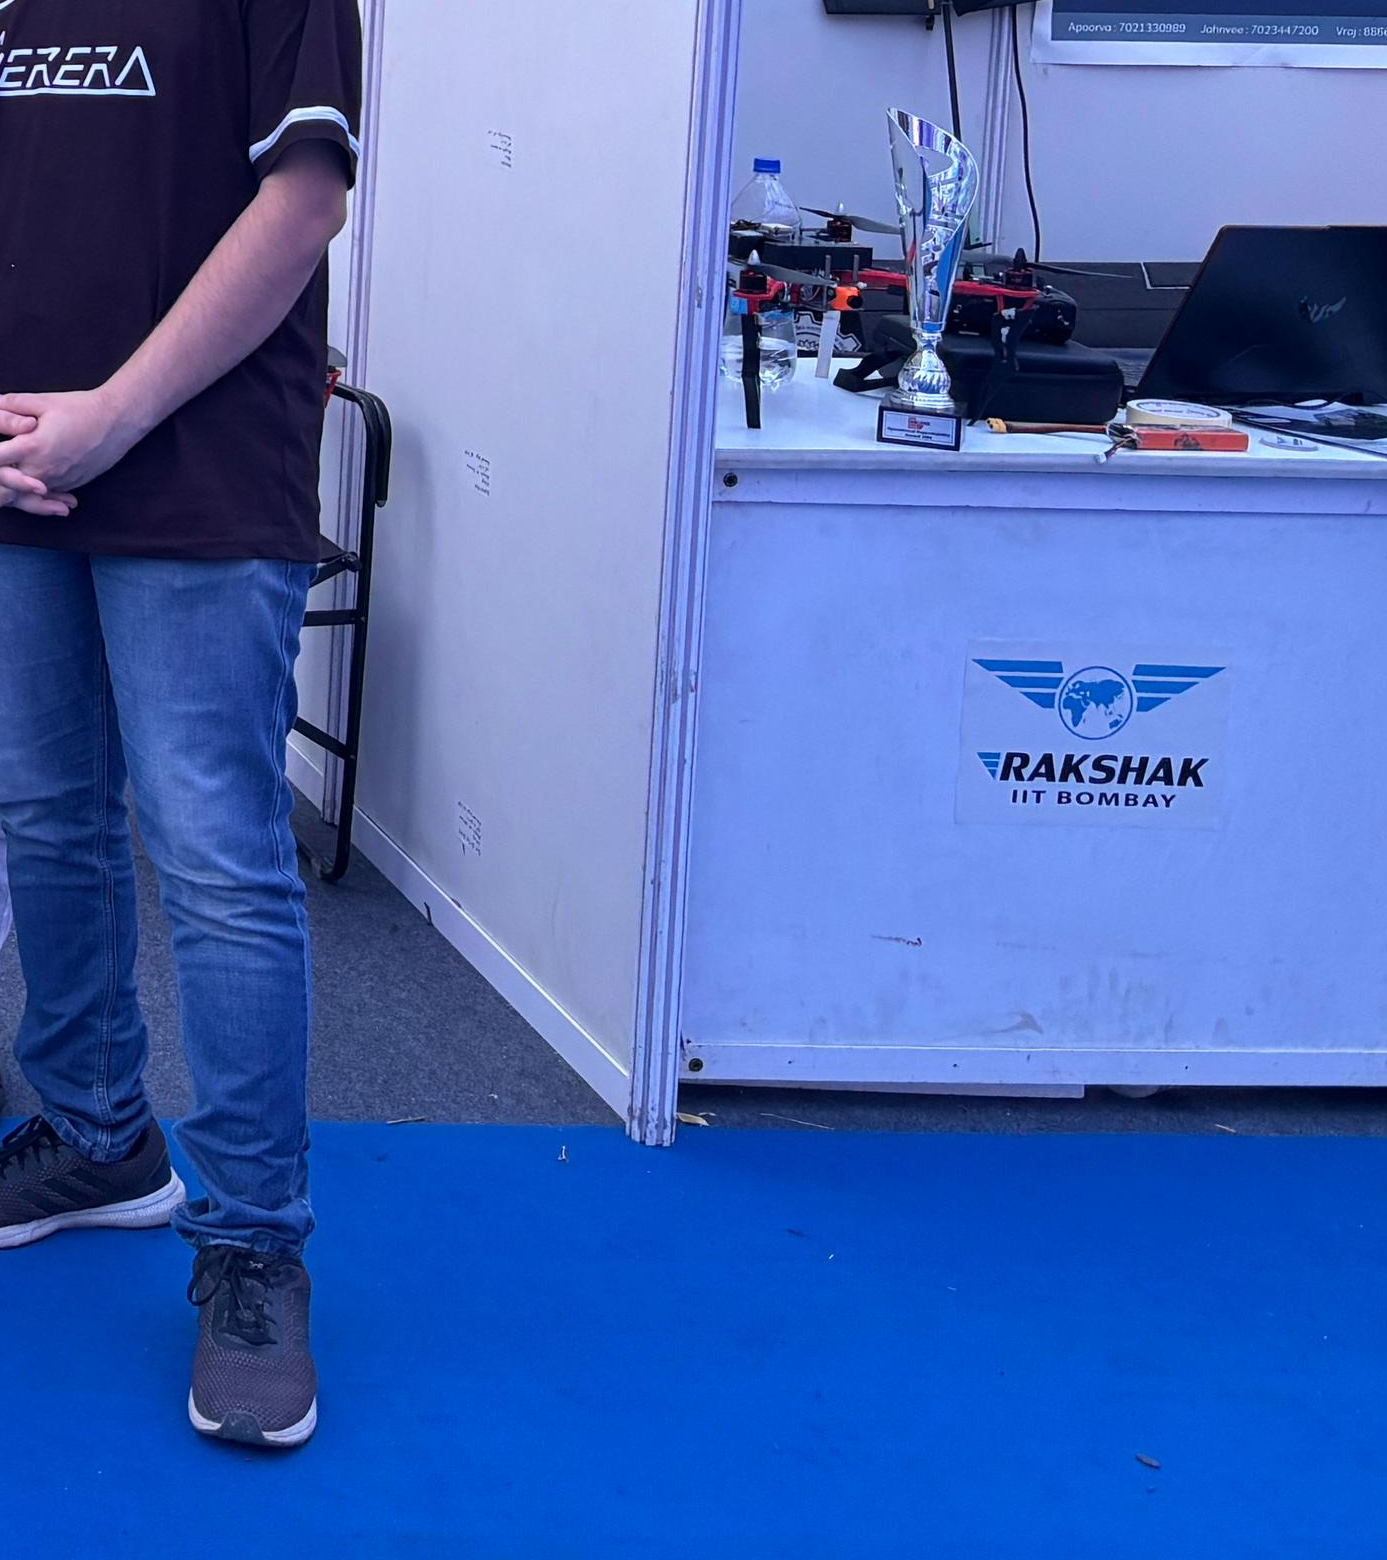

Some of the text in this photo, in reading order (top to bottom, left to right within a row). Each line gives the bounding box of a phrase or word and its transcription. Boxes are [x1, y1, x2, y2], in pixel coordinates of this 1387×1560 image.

[1068, 22, 1112, 33] Apoorva
[1119, 22, 1186, 33] 7021330989
[1251, 25, 1319, 36] 7023447200
[999, 751, 1210, 788] RAKSHAK
[1011, 789, 1177, 809] IIT BOMBAY
